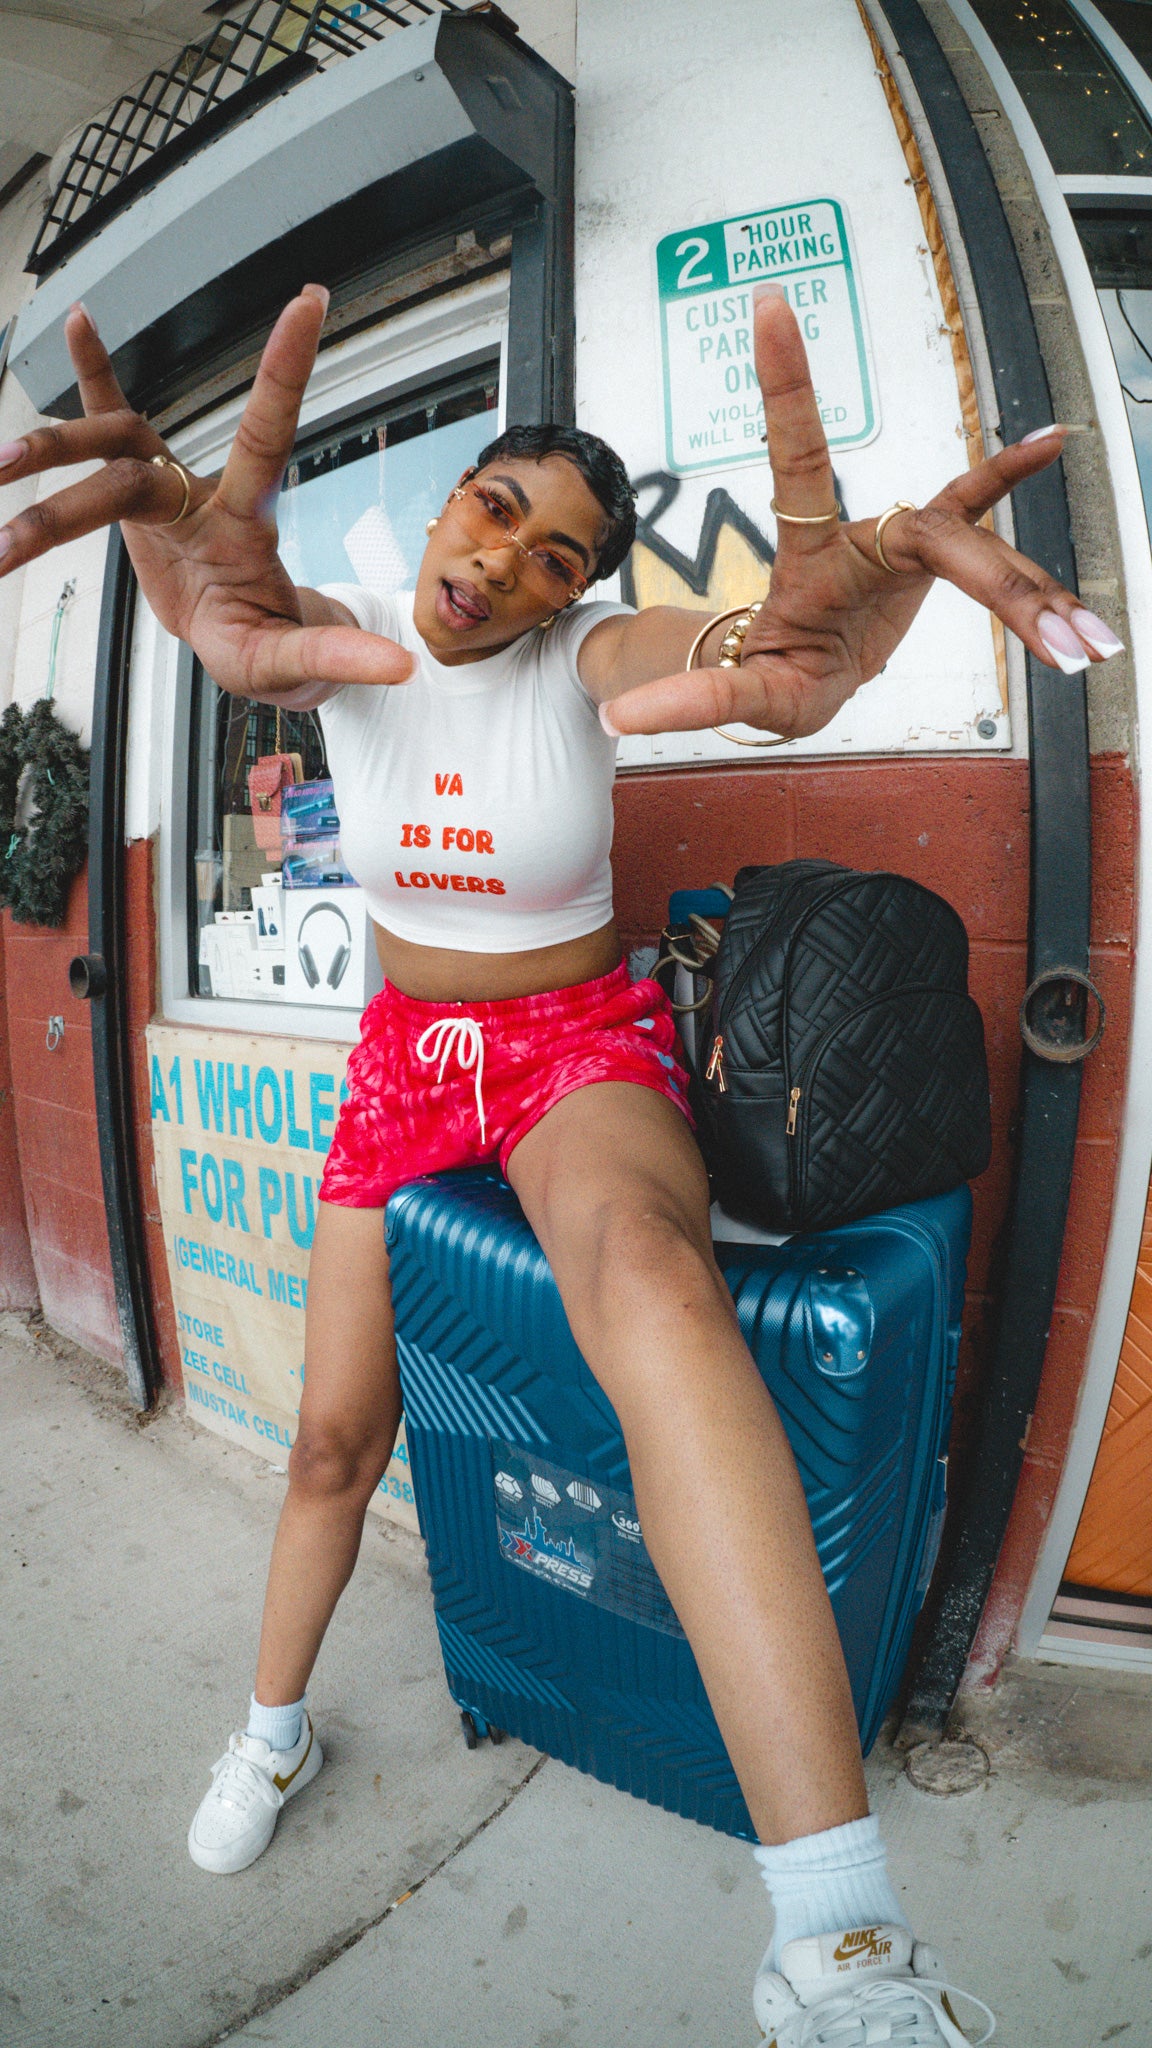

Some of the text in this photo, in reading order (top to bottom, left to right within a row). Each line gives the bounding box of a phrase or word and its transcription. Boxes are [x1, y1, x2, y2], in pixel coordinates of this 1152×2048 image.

[750, 213, 813, 245] HOUR
[675, 237, 714, 290] 2
[733, 233, 835, 274] PARKING
[686, 279, 828, 332] CUSTER
[700, 313, 820, 363] PARG
[708, 390, 823, 424] VIOLAS
[688, 421, 767, 449] WILL BE
[435, 773, 463, 796] VA
[400, 823, 496, 855] IS FOR
[394, 871, 507, 896] LOVERS
[151, 1054, 351, 1155] A1 WHOLE
[180, 1148, 250, 1233] FOR
[174, 1234, 262, 1297] (GENERAL
[177, 1310, 225, 1348] STORE
[182, 1346, 211, 1376] ZEE
[212, 1361, 252, 1395] CELL
[188, 1380, 294, 1450] MUSTAK CELL
[842, 1928, 878, 1949] NIKE
[867, 1941, 893, 1958] AIR
[837, 1962, 851, 1973] AIR
[856, 1955, 883, 1969] FORCE
